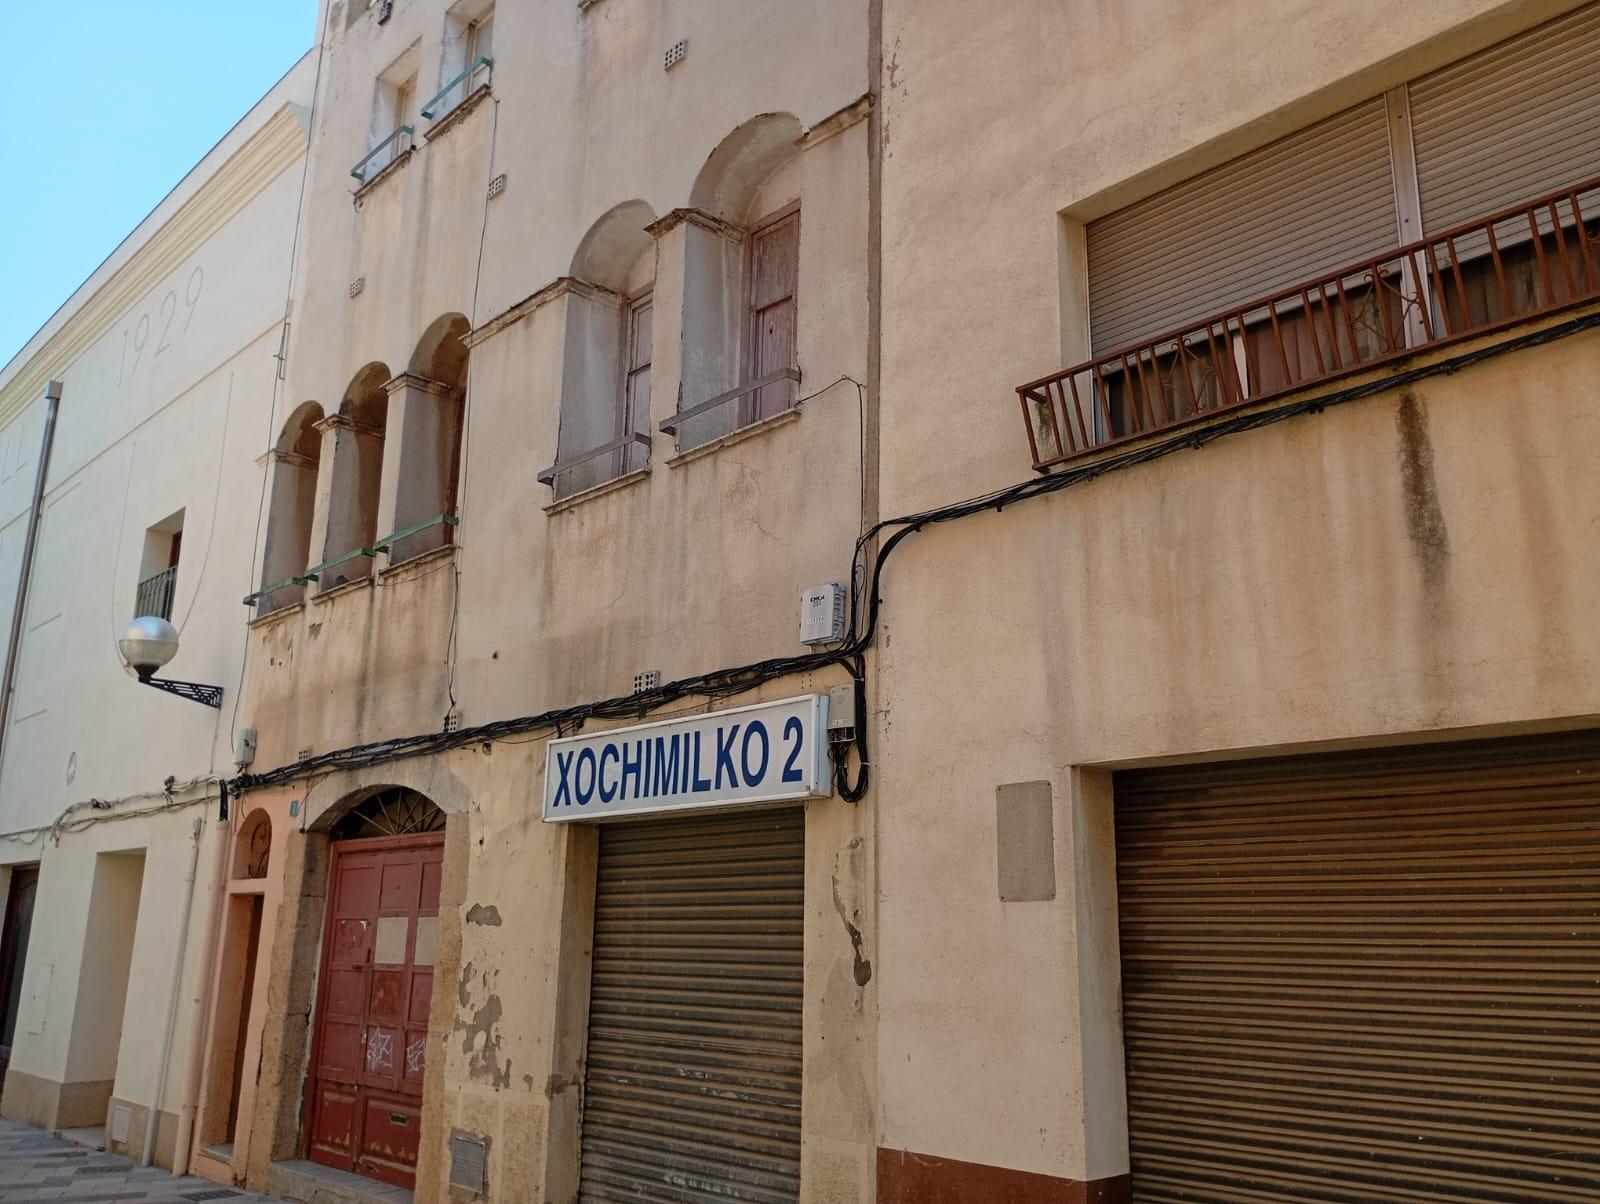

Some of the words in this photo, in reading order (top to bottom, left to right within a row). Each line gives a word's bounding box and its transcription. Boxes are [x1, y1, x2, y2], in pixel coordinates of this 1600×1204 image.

[118, 265, 204, 387] 1929
[552, 719, 769, 808] XOCHIMILKO
[781, 716, 803, 783] 2
